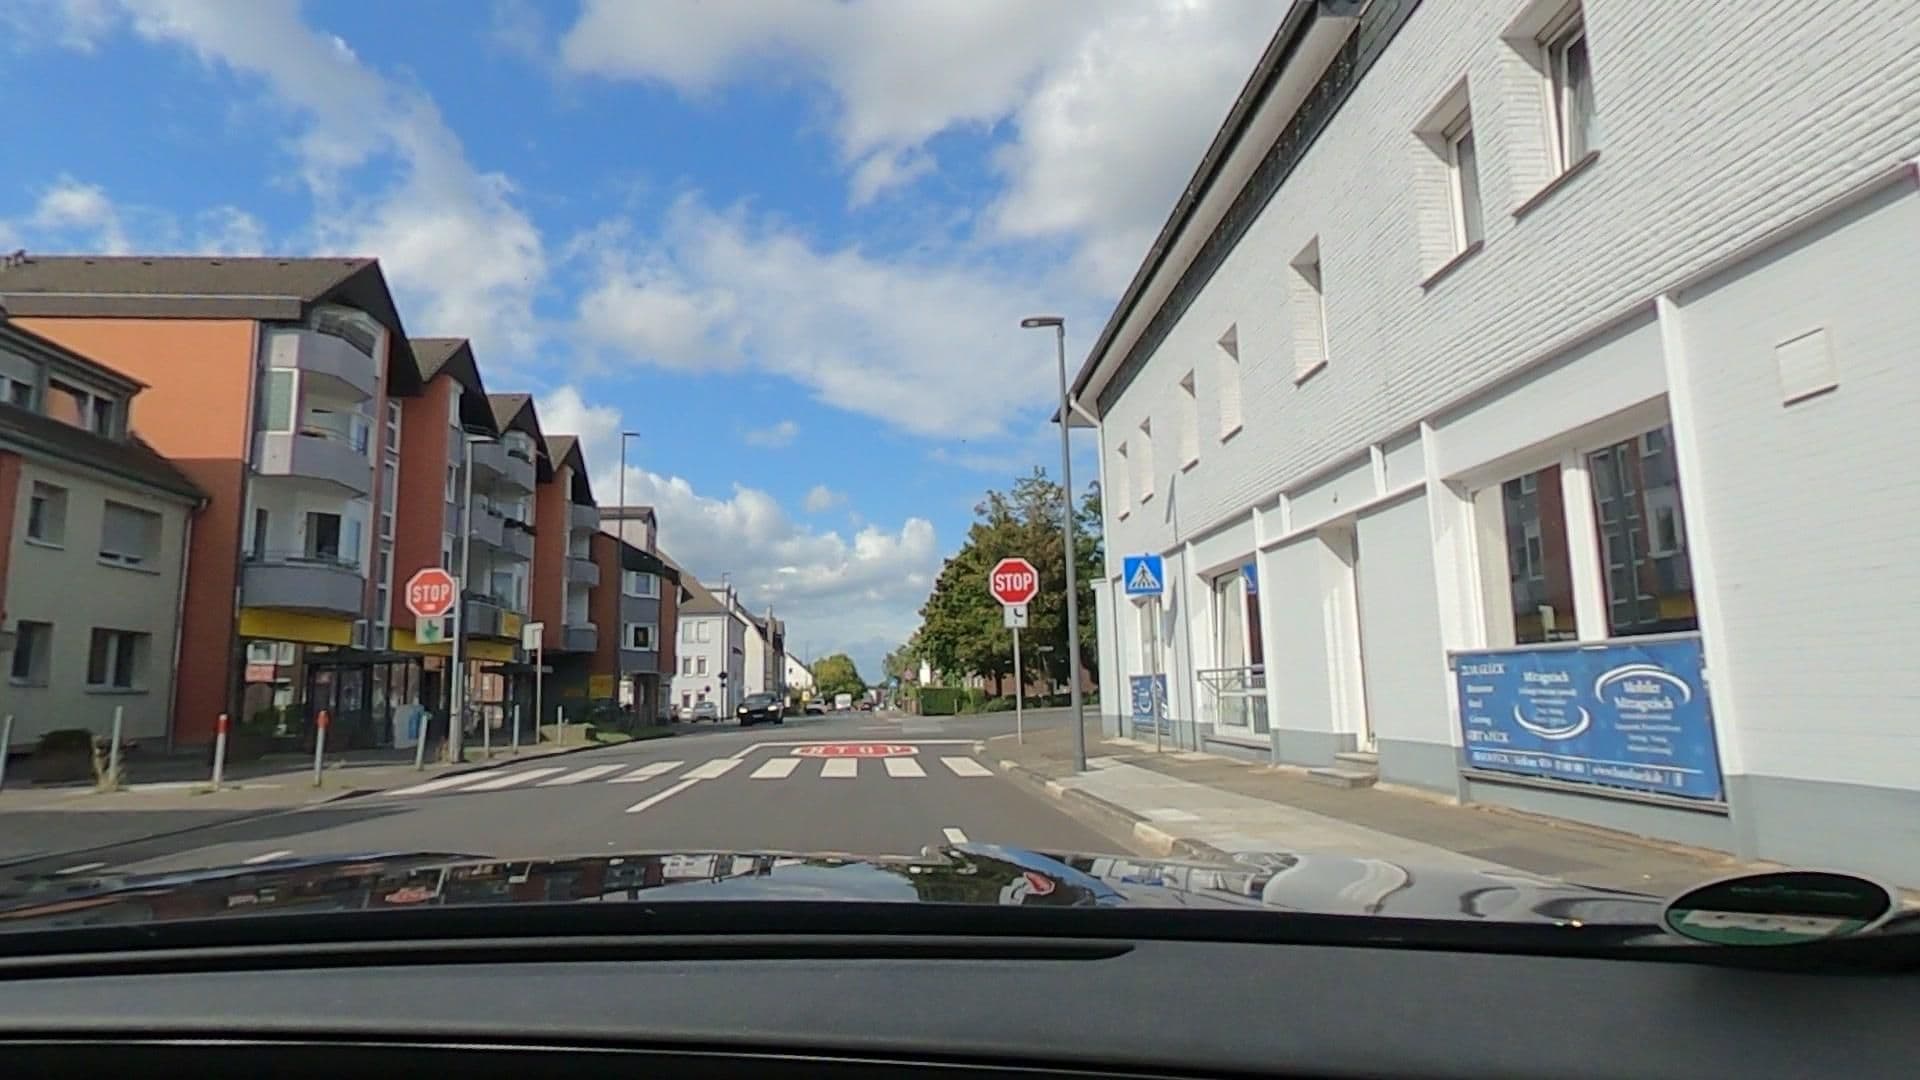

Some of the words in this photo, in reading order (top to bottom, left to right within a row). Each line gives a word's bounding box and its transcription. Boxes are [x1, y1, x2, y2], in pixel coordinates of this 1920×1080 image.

[995, 573, 1032, 592] STOP
[413, 584, 450, 602] STOP
[809, 745, 902, 756] STOP
